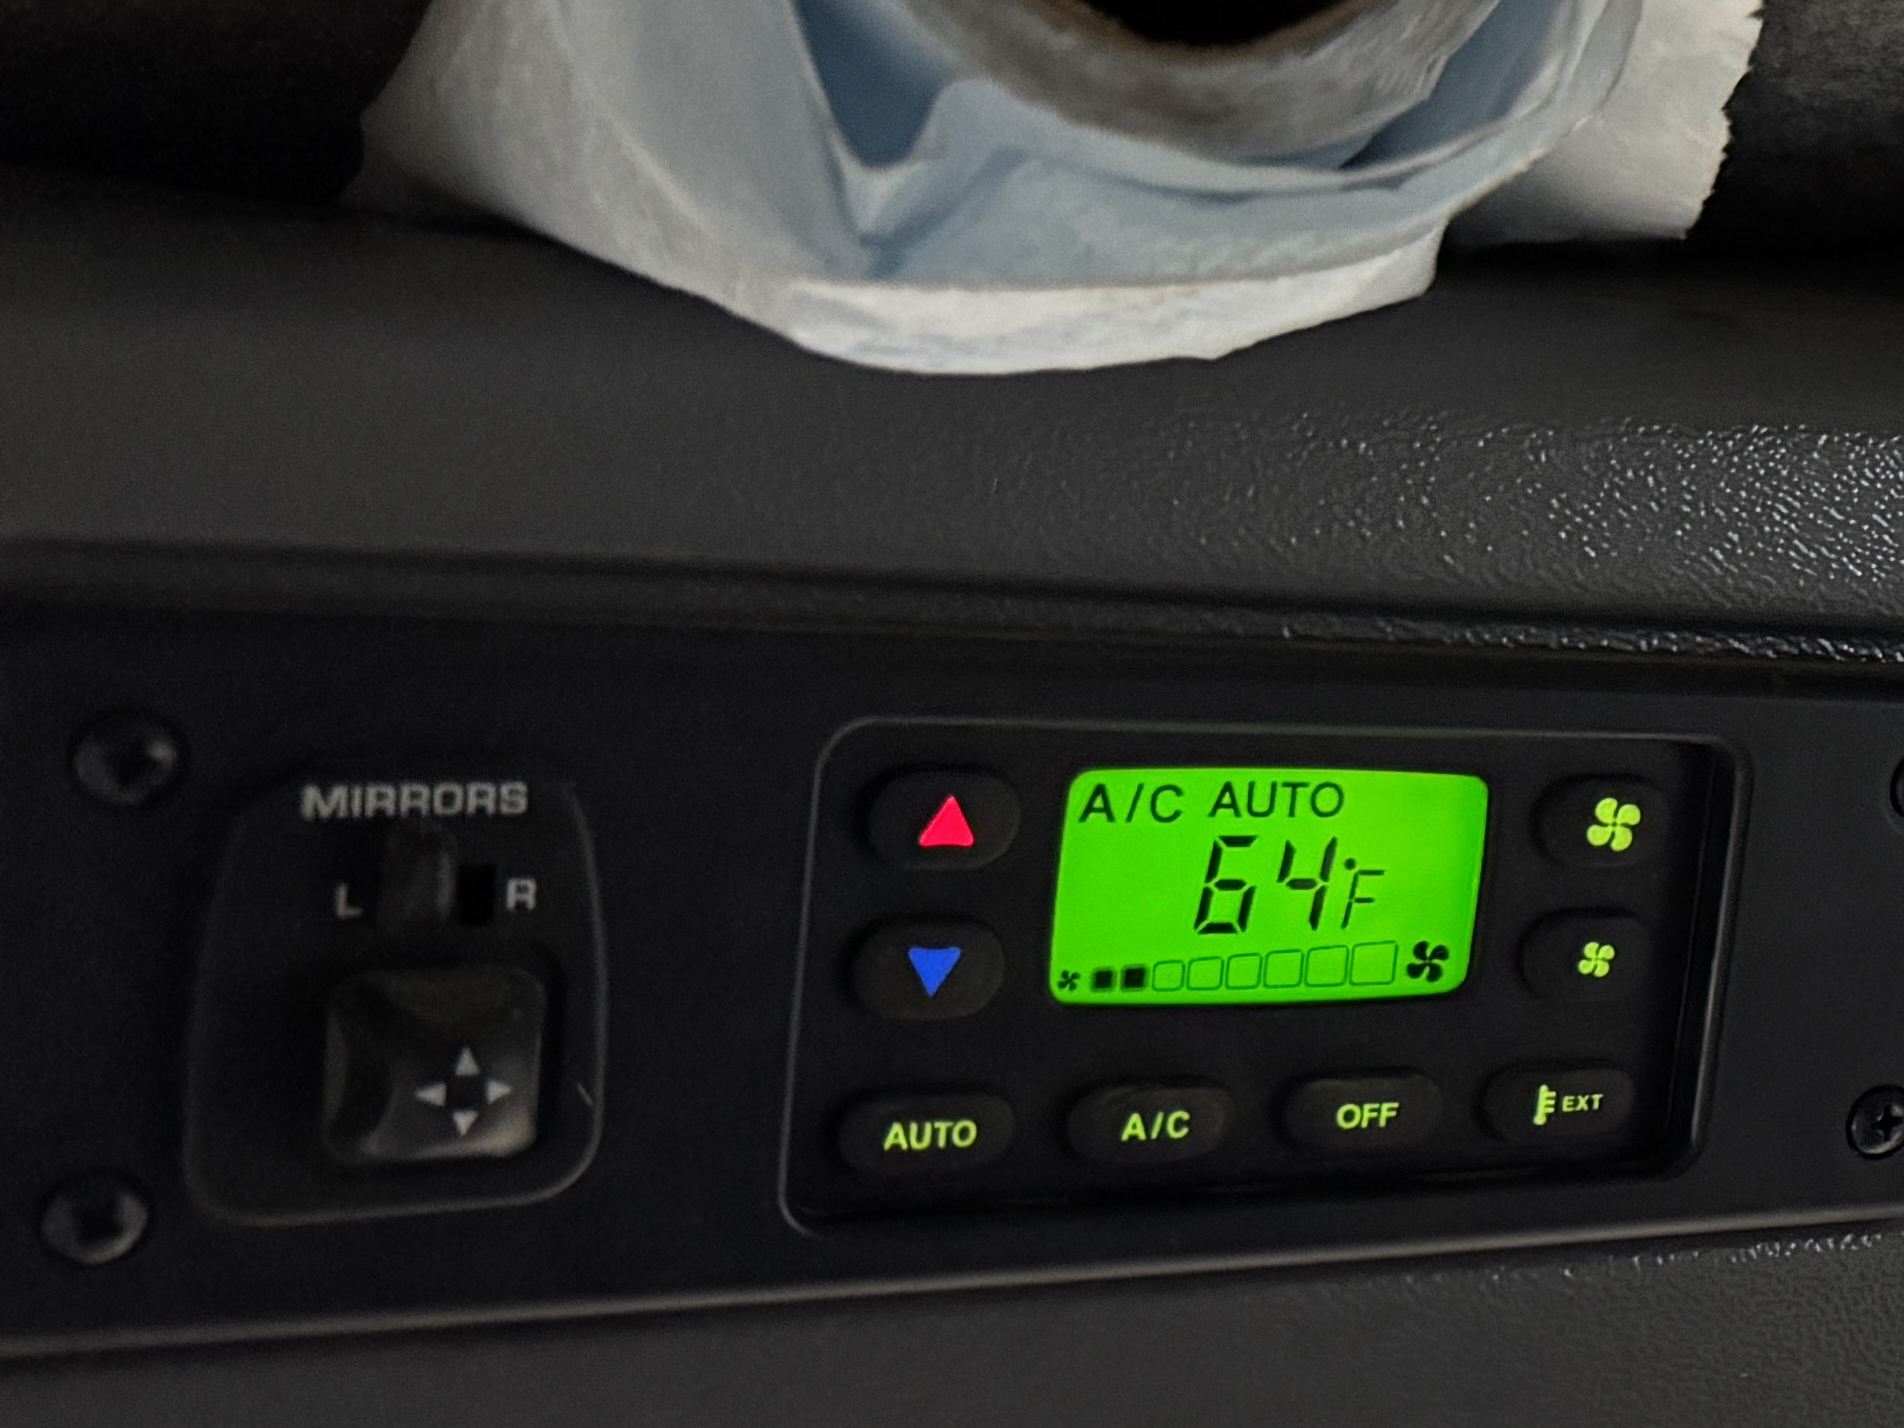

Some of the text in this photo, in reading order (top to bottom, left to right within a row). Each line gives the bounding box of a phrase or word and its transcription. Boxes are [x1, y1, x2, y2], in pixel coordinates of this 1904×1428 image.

[302, 781, 529, 819] MIRRORS
[1079, 782, 1345, 824] A/C AUTO
[335, 883, 363, 919] L
[506, 877, 537, 911] R
[1336, 1101, 1400, 1133] OFF
[1560, 1091, 1605, 1114] EXT
[884, 1118, 978, 1153] AUTO
[1121, 1109, 1191, 1143] A/C
